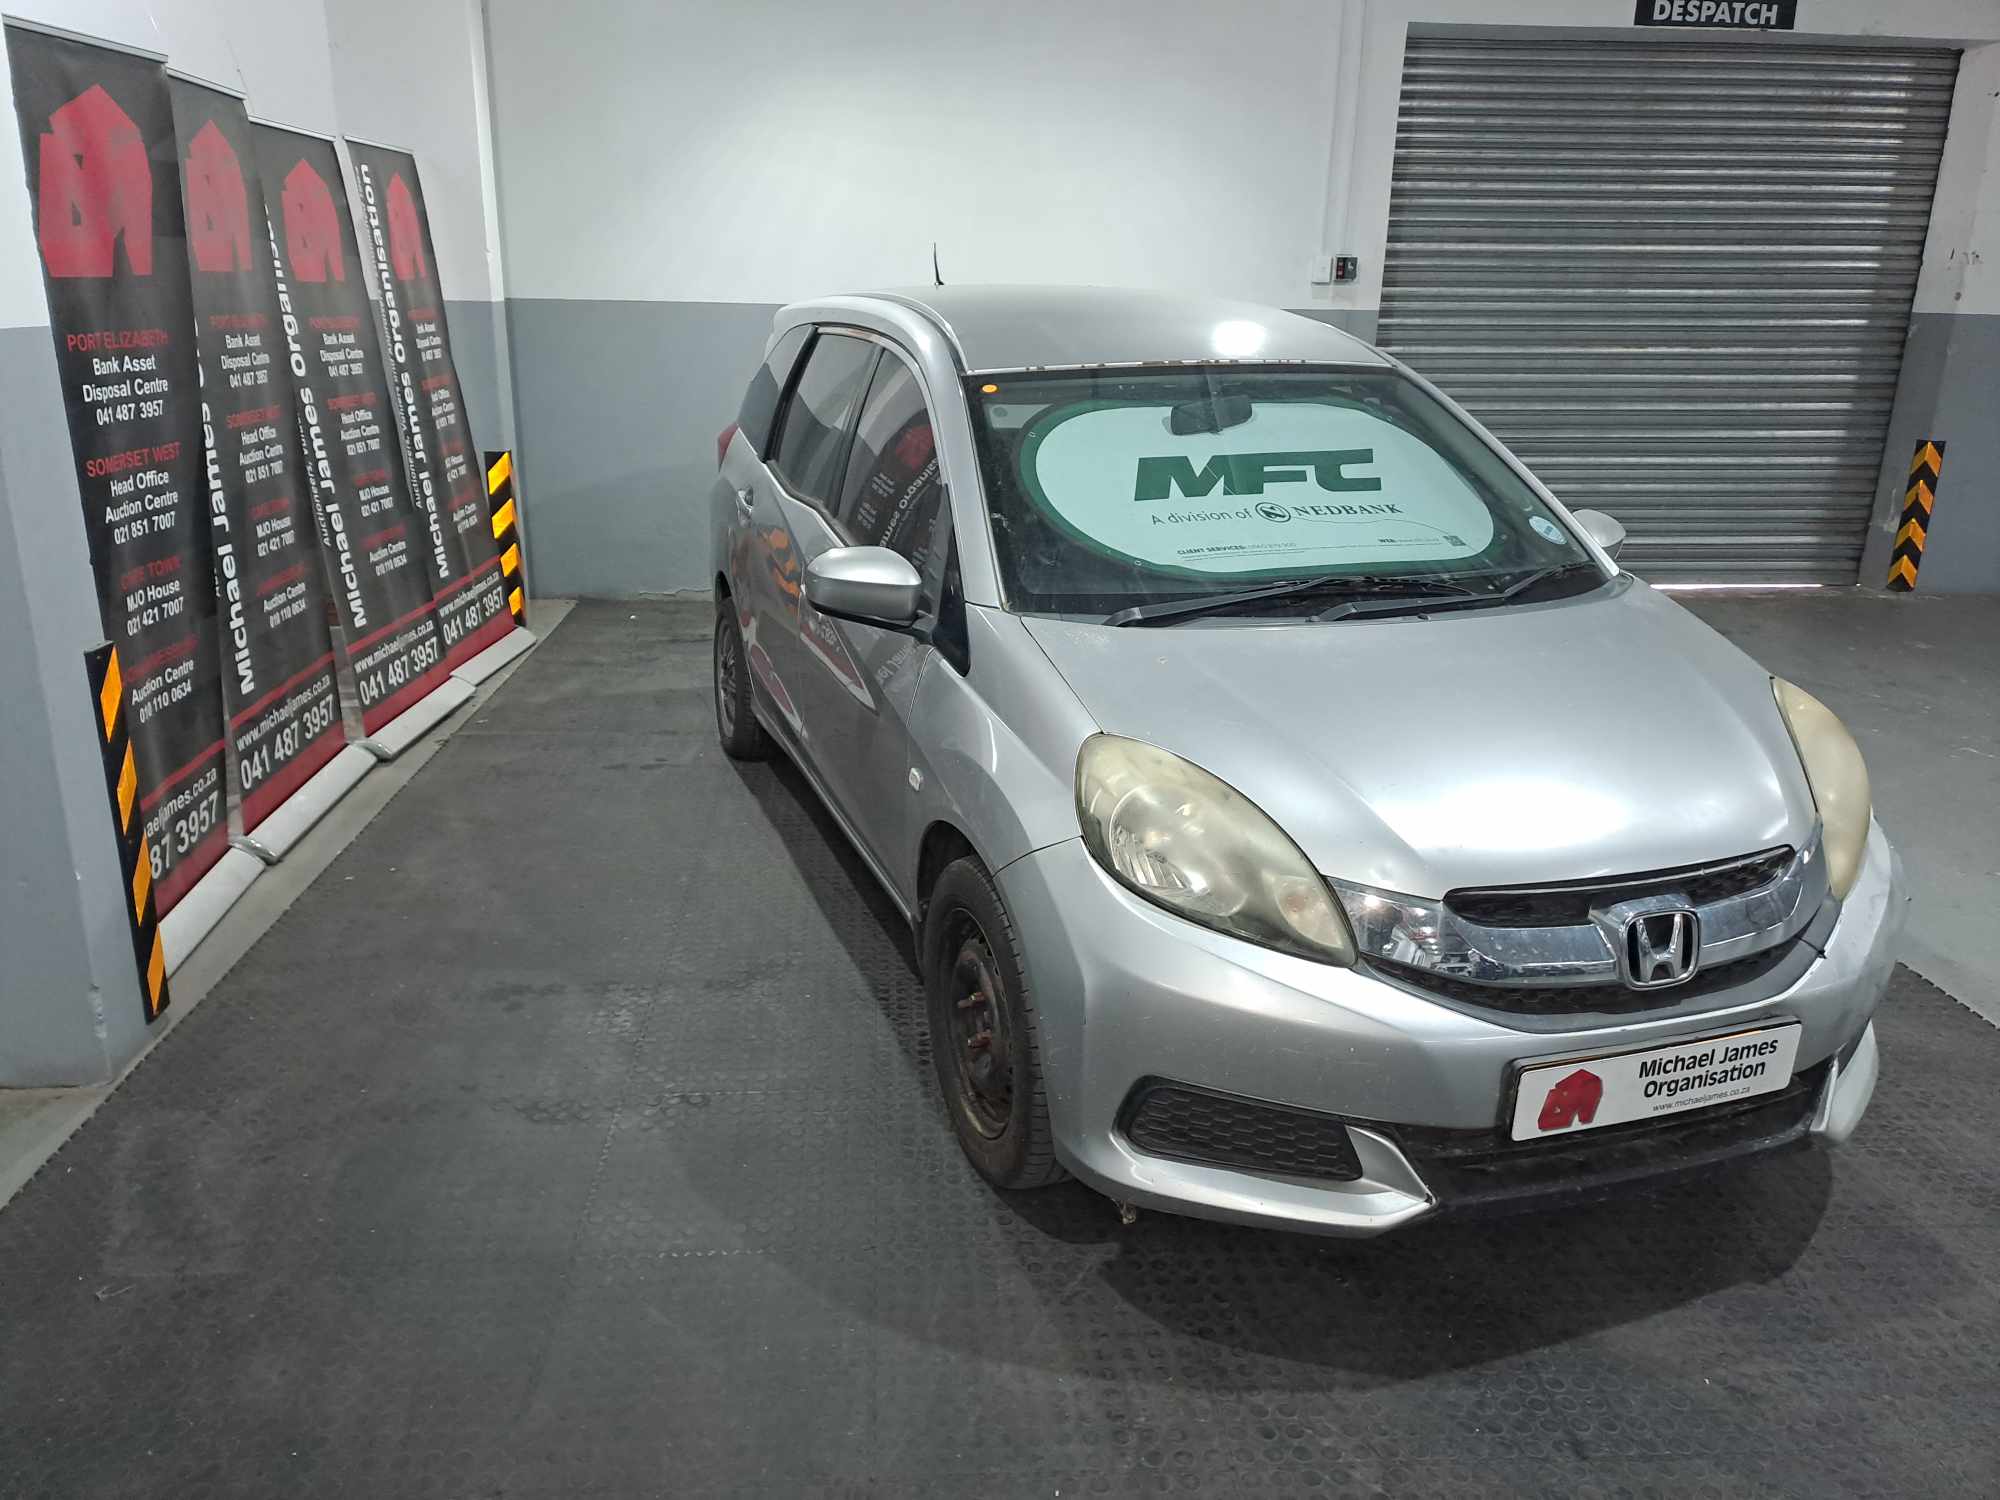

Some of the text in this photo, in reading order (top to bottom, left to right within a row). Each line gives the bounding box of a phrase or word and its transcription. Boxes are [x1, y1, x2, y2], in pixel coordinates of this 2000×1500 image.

[1653, 0, 1778, 25] DESPATCH
[361, 164, 406, 363] Organisation
[66, 332, 100, 352] PORT
[92, 354, 156, 376] Bank Asset
[82, 377, 168, 403] Disposal Centre
[96, 400, 164, 426] 041 487 3957
[401, 372, 427, 463] James
[300, 387, 336, 494] James
[86, 442, 181, 478] SOMERSET WEST
[1134, 449, 1382, 501] MFC
[110, 469, 169, 497] Head Office
[105, 490, 179, 524] Auction Centre
[419, 471, 449, 579] Michael
[1151, 508, 1251, 525] A division of
[1290, 504, 1403, 516] NEDBANK
[114, 511, 176, 544] 021 851 7007
[326, 503, 367, 628] Michael
[147, 580, 180, 601] House
[127, 597, 184, 636] 021 421 7007
[217, 543, 255, 695] Michael
[443, 615, 464, 645] 041
[483, 586, 504, 617] 3957
[131, 674, 163, 706] Auction
[164, 659, 194, 682] Centre
[359, 636, 438, 705] 041 487 3957
[153, 691, 169, 709] 110
[171, 679, 192, 702] 0634
[240, 693, 334, 789] 041 487 3957
[150, 790, 218, 879] 87 3957
[1639, 1039, 1778, 1079] Michael James
[1643, 1061, 1766, 1099] Organisation
[1652, 1086, 1751, 1112] www.michaeljames.co.za
